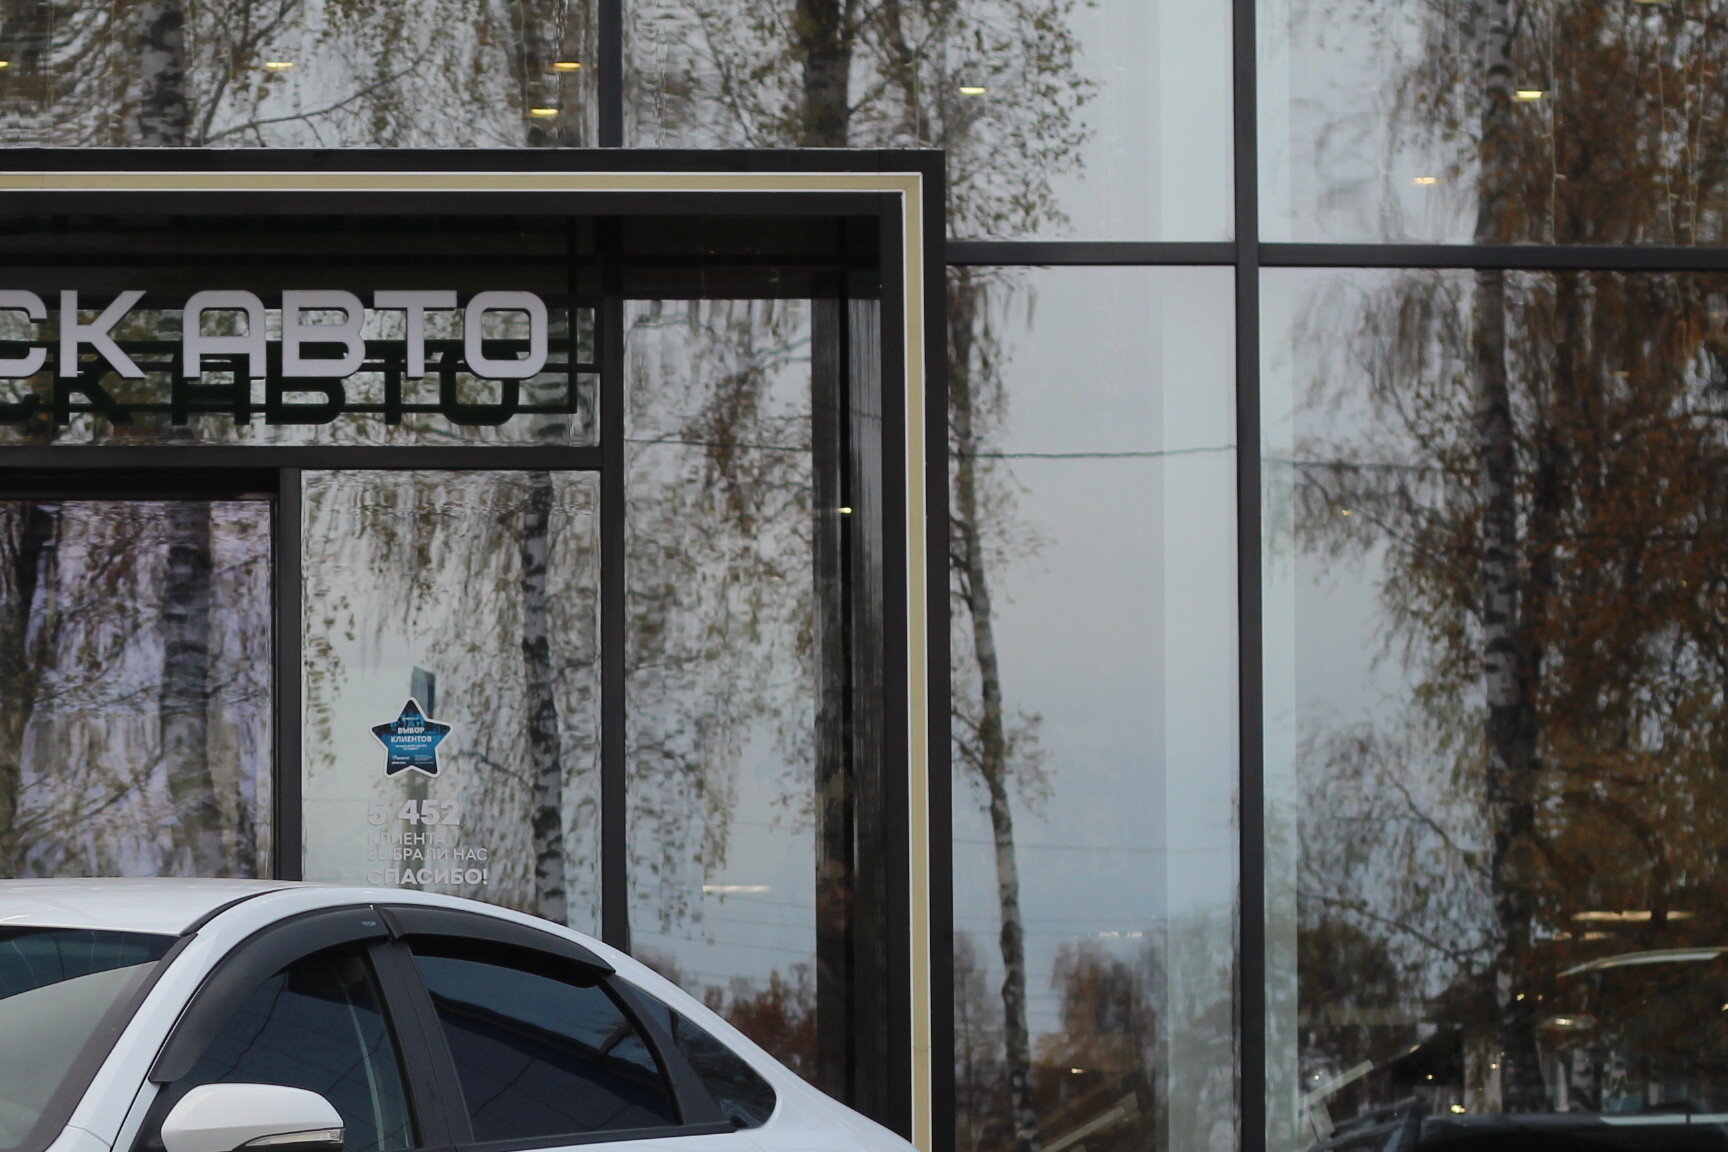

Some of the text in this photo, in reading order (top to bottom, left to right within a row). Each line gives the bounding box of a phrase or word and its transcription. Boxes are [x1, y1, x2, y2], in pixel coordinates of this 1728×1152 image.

[183, 288, 549, 380] АВТО
[398, 799, 460, 826] 452
[367, 832, 446, 846] КЛИЕНТА
[367, 848, 488, 861] ВЫБРАЛИ НАС
[366, 868, 488, 886] СПАСИБО!
